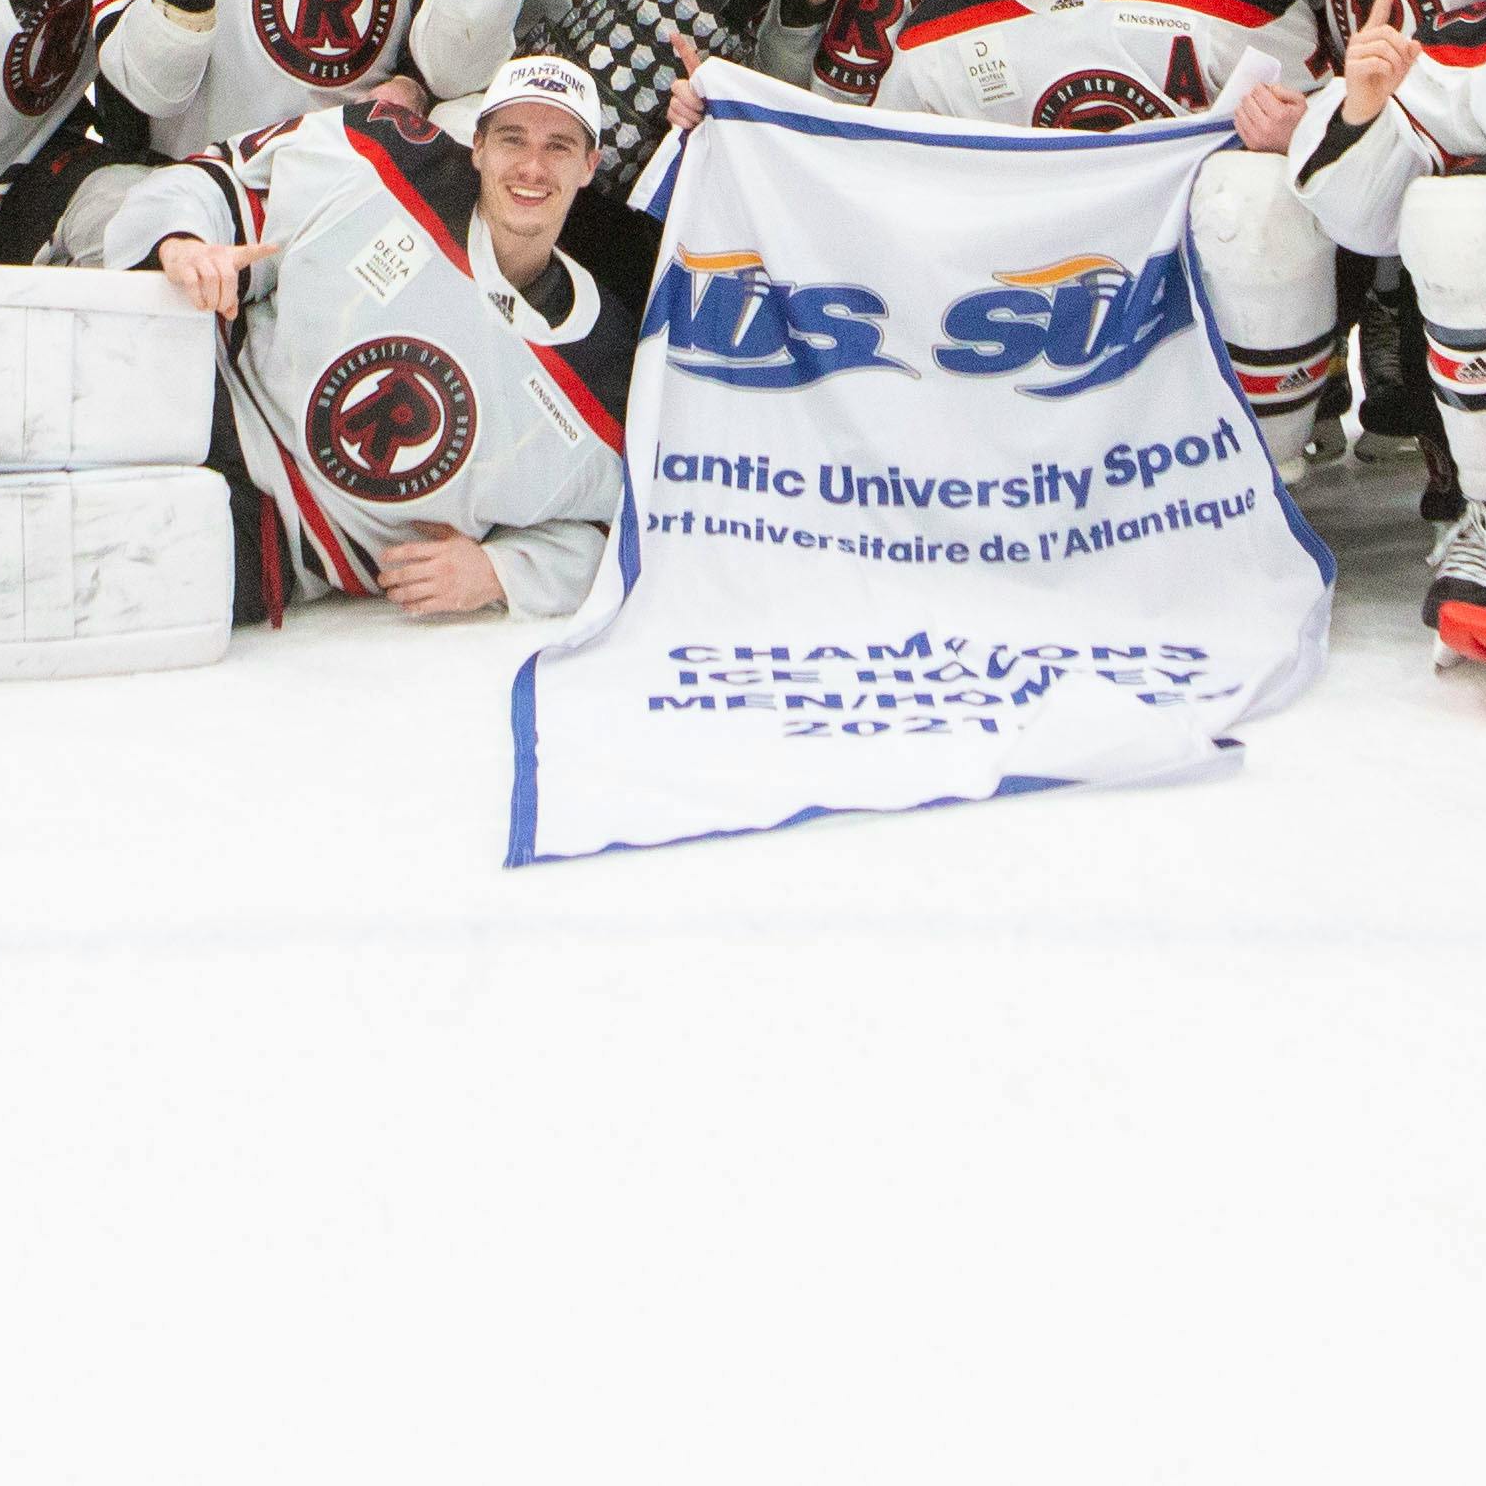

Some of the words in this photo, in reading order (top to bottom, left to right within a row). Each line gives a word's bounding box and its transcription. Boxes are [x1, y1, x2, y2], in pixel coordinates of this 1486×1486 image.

[1118, 12, 1192, 32] KINGSWOOD
[308, 61, 351, 79] REDS
[510, 66, 586, 102] CHAMPIONS
[969, 60, 1007, 78] DELTA
[1164, 35, 1211, 110] A
[528, 377, 579, 442] KINGSWOOD
[818, 462, 1093, 511] University
[703, 515, 970, 565] universitaire
[979, 534, 1031, 564] de
[1039, 486, 1257, 563] l'Atlantique
[679, 669, 822, 686] ICE
